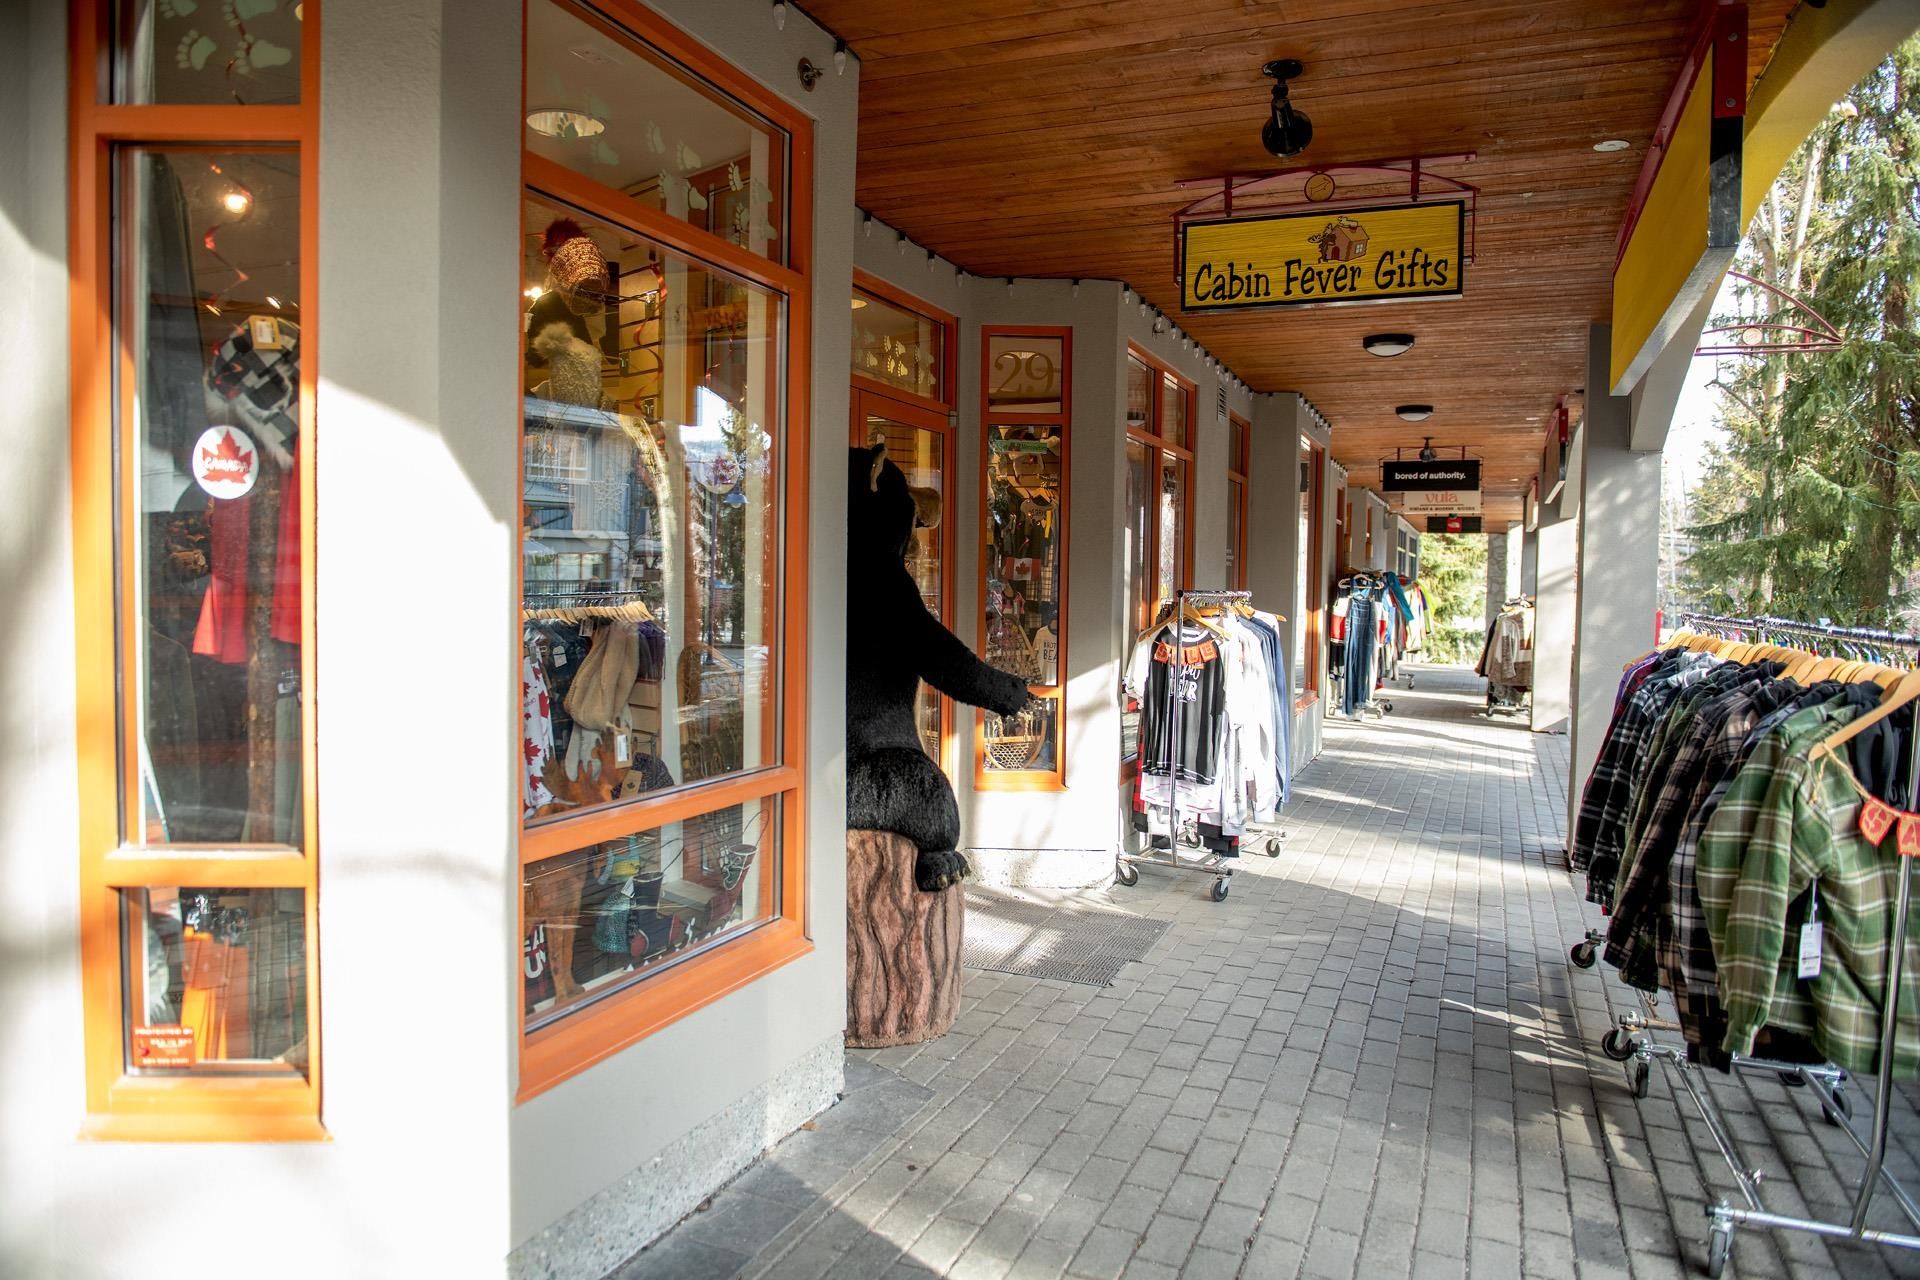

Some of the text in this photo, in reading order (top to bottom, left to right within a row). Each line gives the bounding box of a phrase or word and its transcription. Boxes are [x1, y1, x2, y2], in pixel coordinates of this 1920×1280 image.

[1194, 247, 1448, 301] Cabin Fever Gifts
[994, 352, 1054, 397] 29
[1395, 472, 1418, 480] bored
[1429, 471, 1466, 480] authority.
